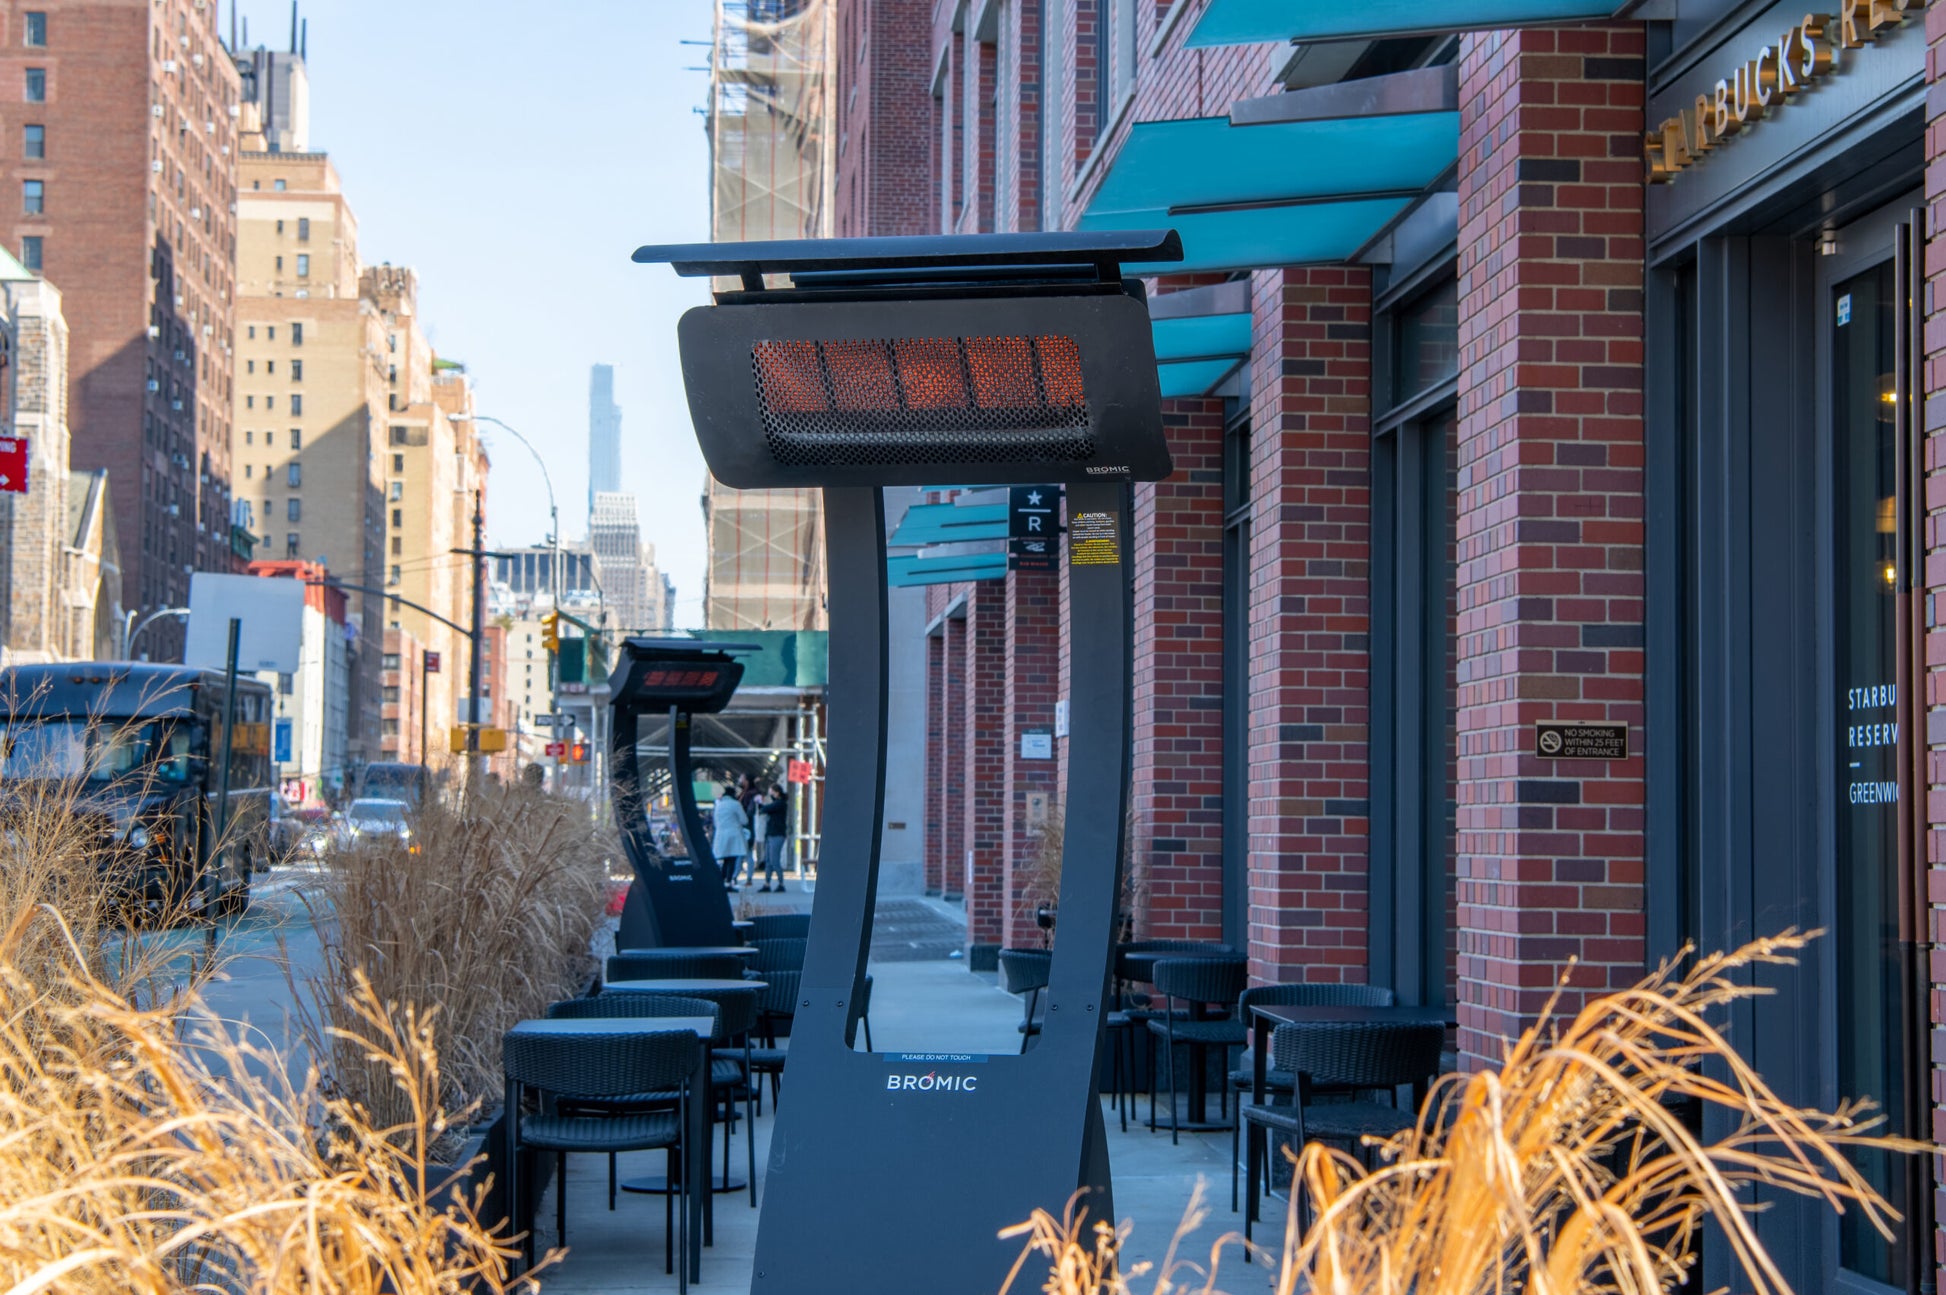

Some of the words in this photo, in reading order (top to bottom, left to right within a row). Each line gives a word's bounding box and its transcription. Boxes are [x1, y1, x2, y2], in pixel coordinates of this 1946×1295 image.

[1645, 13, 1832, 185] STARBUCKS
[1086, 466, 1130, 474] BROMIC
[1028, 516, 1042, 532] R
[1848, 684, 1896, 710] STARBU
[1564, 728, 1578, 737] NO
[1578, 729, 1615, 738] SMOKING
[1564, 738, 1594, 747] WITHIN
[1594, 738, 1604, 747] 25
[1605, 739, 1624, 747] FEET
[1564, 747, 1576, 756] OF
[1577, 748, 1620, 756] ENTRANCE
[887, 1073, 977, 1091] BROMIC
